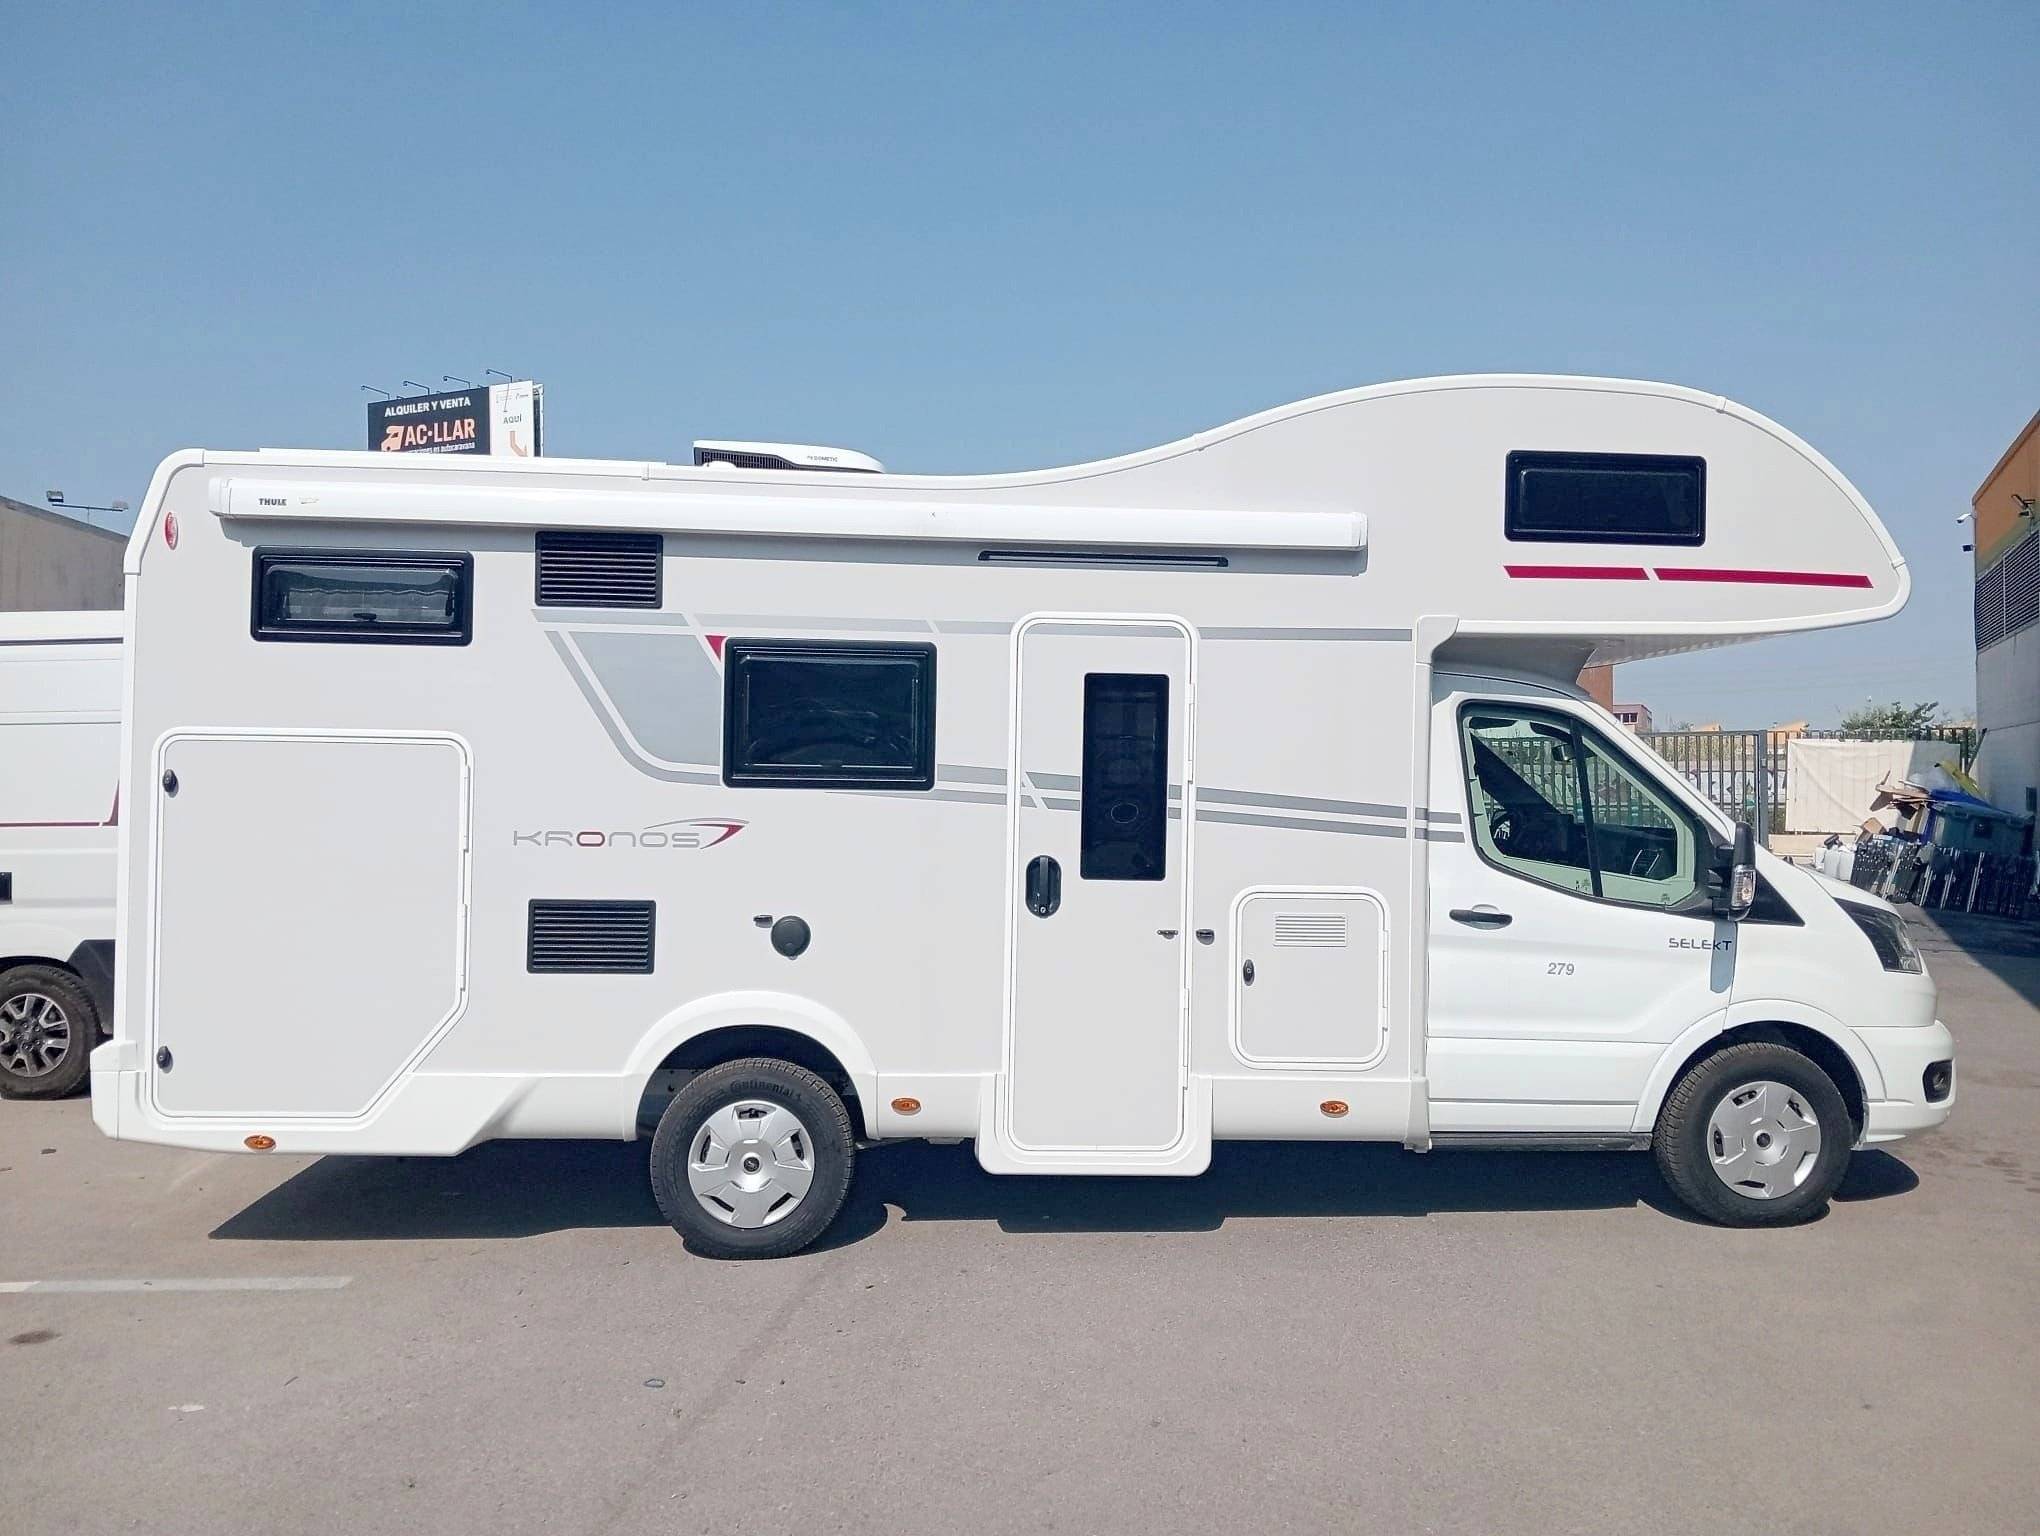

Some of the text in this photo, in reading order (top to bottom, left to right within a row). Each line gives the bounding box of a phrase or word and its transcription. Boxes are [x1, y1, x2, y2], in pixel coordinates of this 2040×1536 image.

[385, 397, 471, 417] ALQUILER Y VENTA
[258, 498, 287, 507] THULE
[1547, 962, 1575, 976] 279
